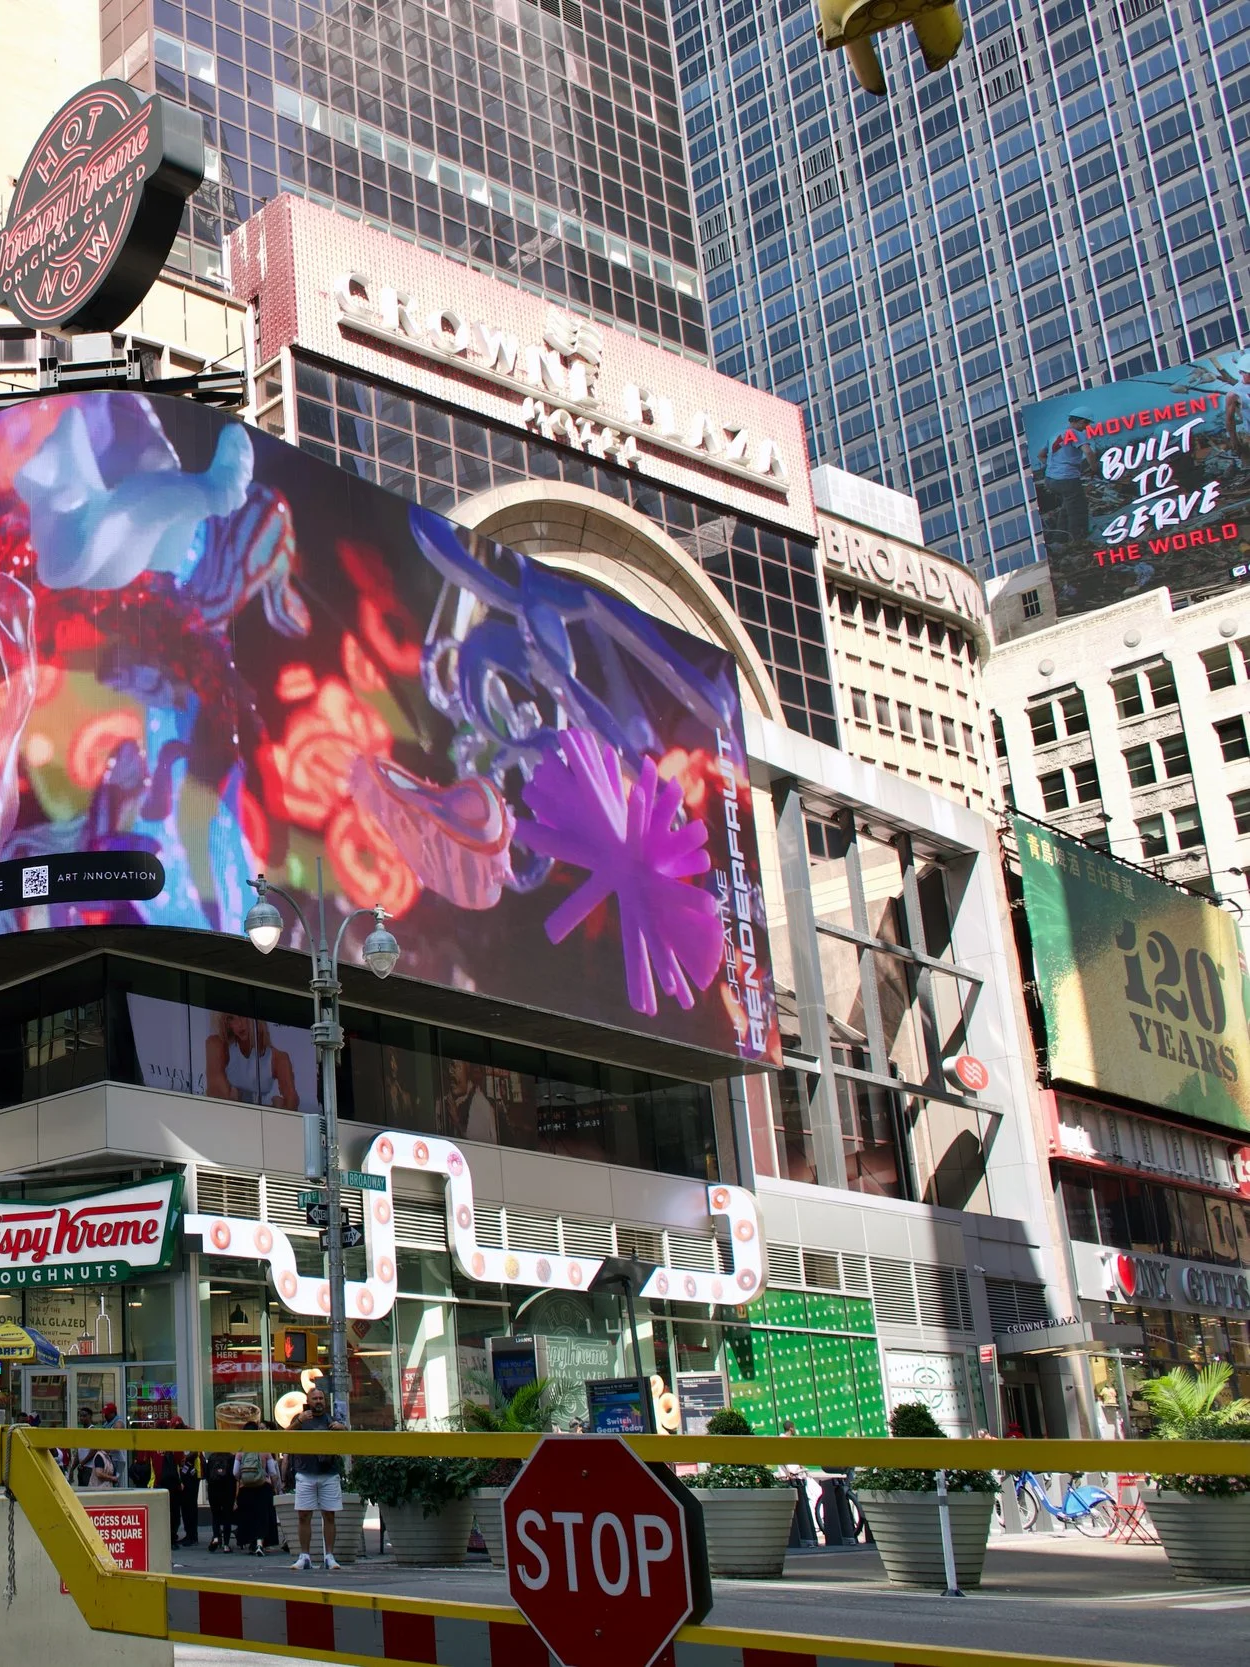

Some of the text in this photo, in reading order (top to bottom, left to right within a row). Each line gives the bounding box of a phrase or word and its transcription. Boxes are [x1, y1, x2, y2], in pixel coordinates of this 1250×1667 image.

[36, 105, 103, 184] HOT
[71, 103, 152, 213] Kreme
[3, 163, 146, 293] ORIGINAL GLAZED
[37, 220, 110, 305] NOW
[334, 270, 789, 481] CROWNE PLAZA
[1063, 393, 1221, 446] A MOVEMENT
[1100, 417, 1205, 481] BUILT
[1132, 463, 1174, 497] TO
[1102, 480, 1220, 544] SERVE
[1094, 522, 1238, 567] THE WORLD
[822, 520, 986, 624] BROADW
[57, 871, 156, 882] ART INNOVATION
[715, 868, 741, 1004] CREATIVE
[1116, 919, 1227, 1034] 120
[1128, 1011, 1239, 1083] YEARS
[349, 1173, 385, 1190] BROADWAY
[53, 1200, 163, 1255] Kreme
[313, 1209, 326, 1219] ONE
[1135, 1258, 1174, 1300] NY
[1182, 1267, 1250, 1310] GIFTS
[49, 1319, 86, 1329] GLAZED
[1007, 1315, 1080, 1334] CROWNE PLAZA
[216, 1351, 238, 1359] HERE
[606, 1417, 632, 1426] Switch
[620, 1424, 644, 1433] Today
[111, 1529, 143, 1541] SQUARE
[121, 1515, 140, 1525] CALL
[124, 1559, 134, 1569] AT
[516, 1509, 673, 1597] STOP
